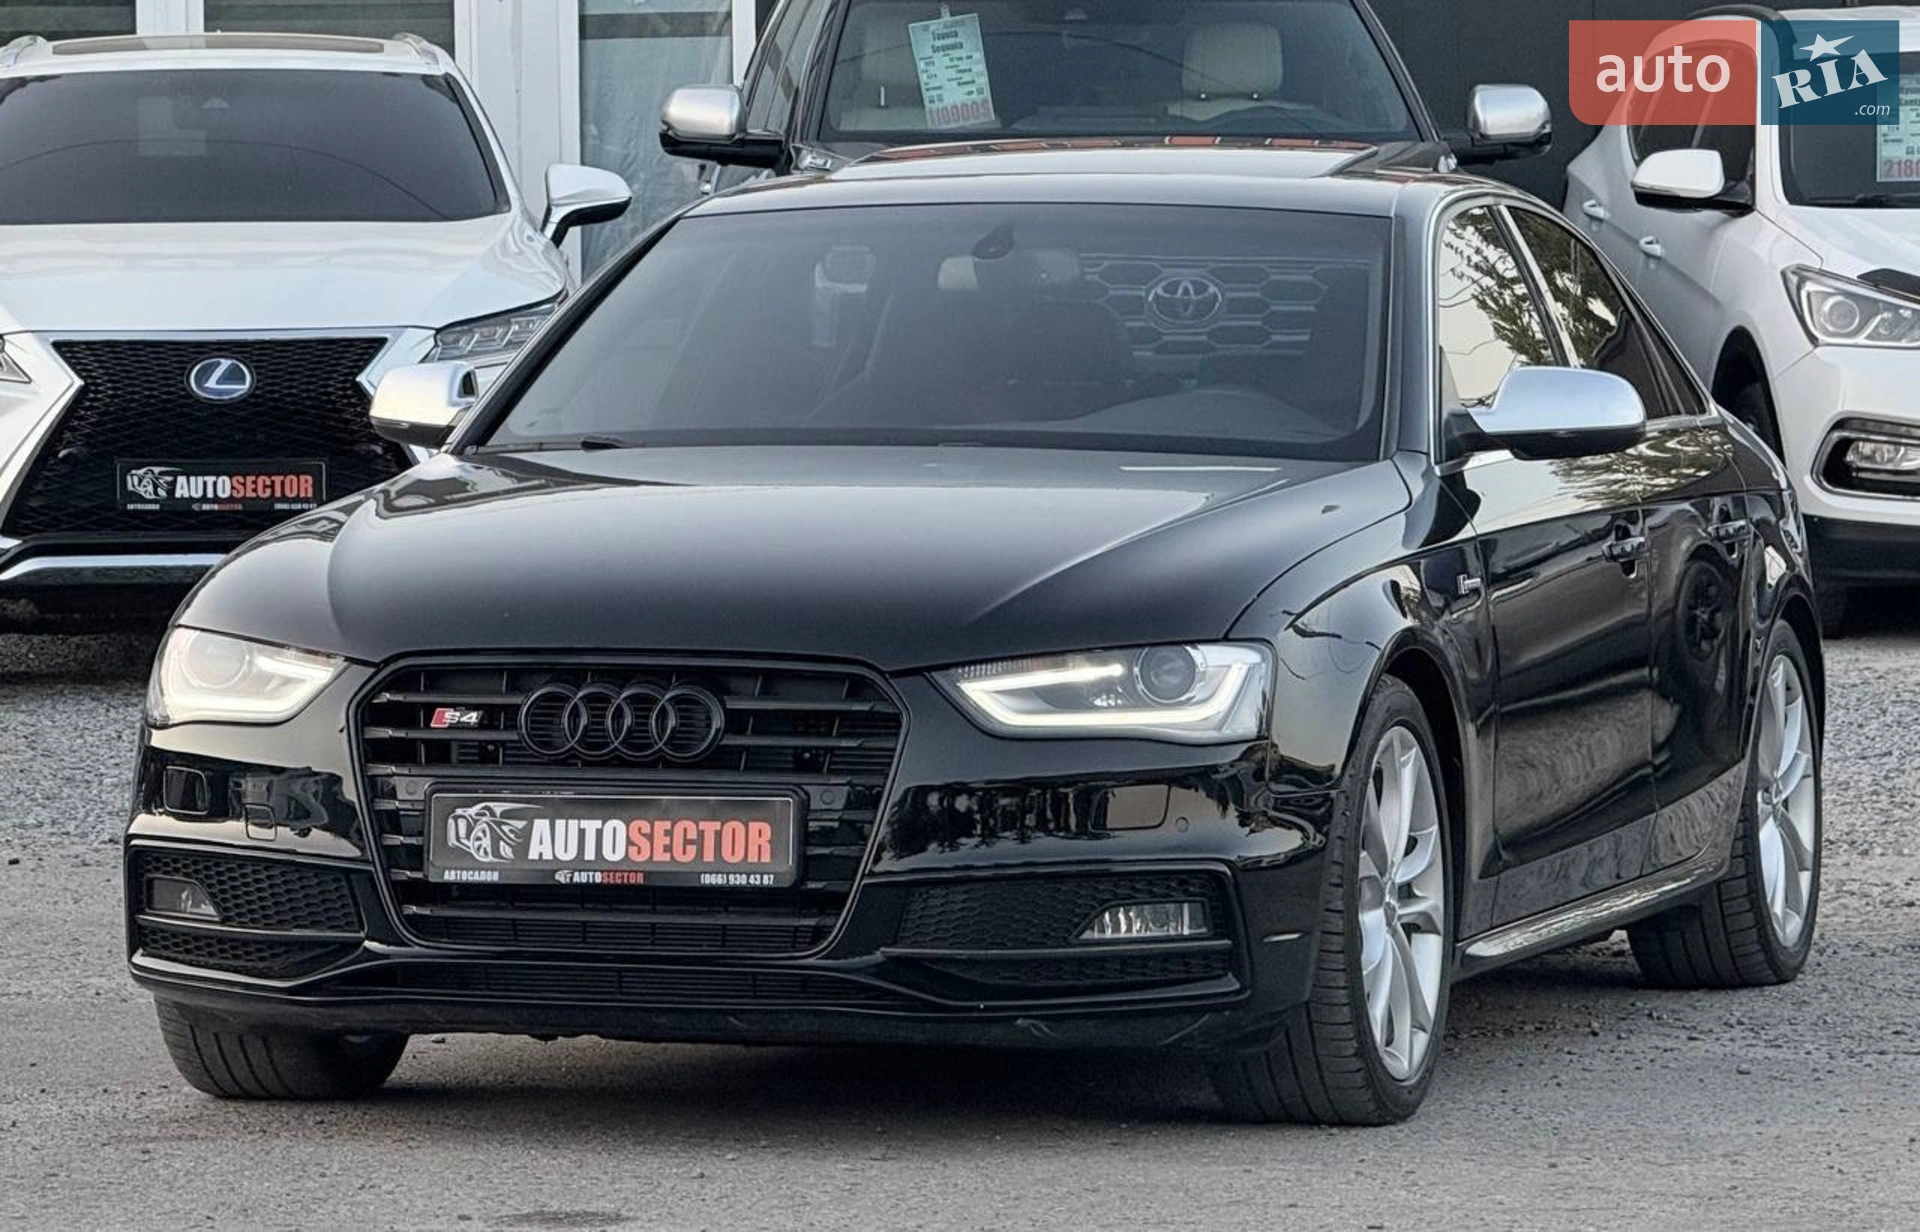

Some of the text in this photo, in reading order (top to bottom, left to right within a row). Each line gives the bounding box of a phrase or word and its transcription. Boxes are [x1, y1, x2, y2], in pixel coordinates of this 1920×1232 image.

[174, 474, 314, 499] AUTOSECTOR
[442, 710, 480, 726] S4
[528, 818, 773, 864] AUTOSECTOR
[572, 871, 644, 884] AUTOSECTOR
